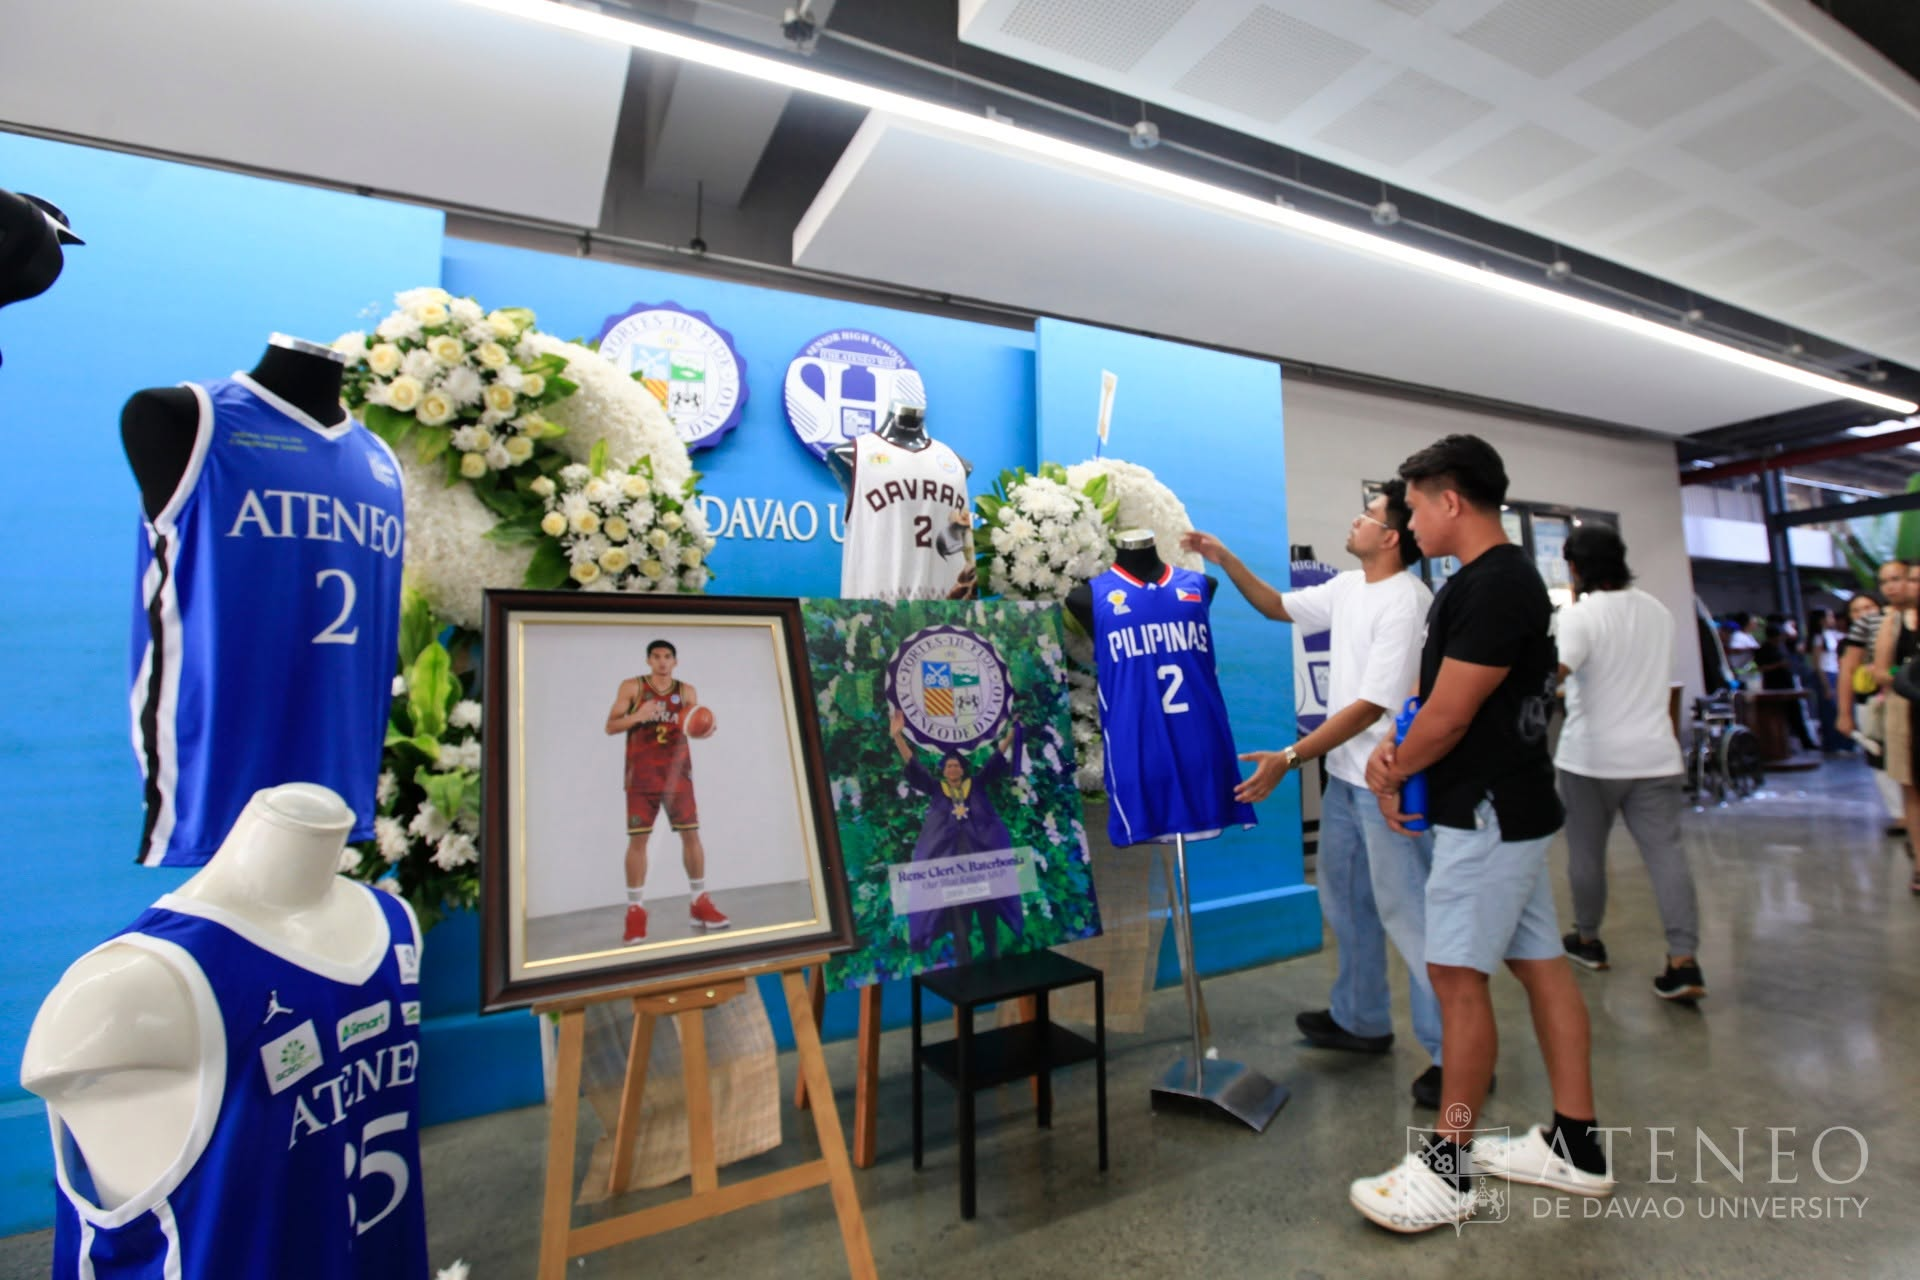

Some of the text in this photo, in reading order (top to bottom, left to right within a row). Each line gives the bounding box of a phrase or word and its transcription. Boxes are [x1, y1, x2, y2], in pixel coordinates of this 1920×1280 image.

[841, 331, 870, 343] HIGH
[871, 336, 907, 368] SCHOOL
[225, 488, 402, 559] ATENEO
[699, 495, 818, 542] DAVAO
[913, 515, 932, 548] 2
[311, 568, 359, 645] 2
[1107, 621, 1208, 663] PILIPINAS
[1156, 664, 1190, 714] 2
[655, 725, 669, 744] 2
